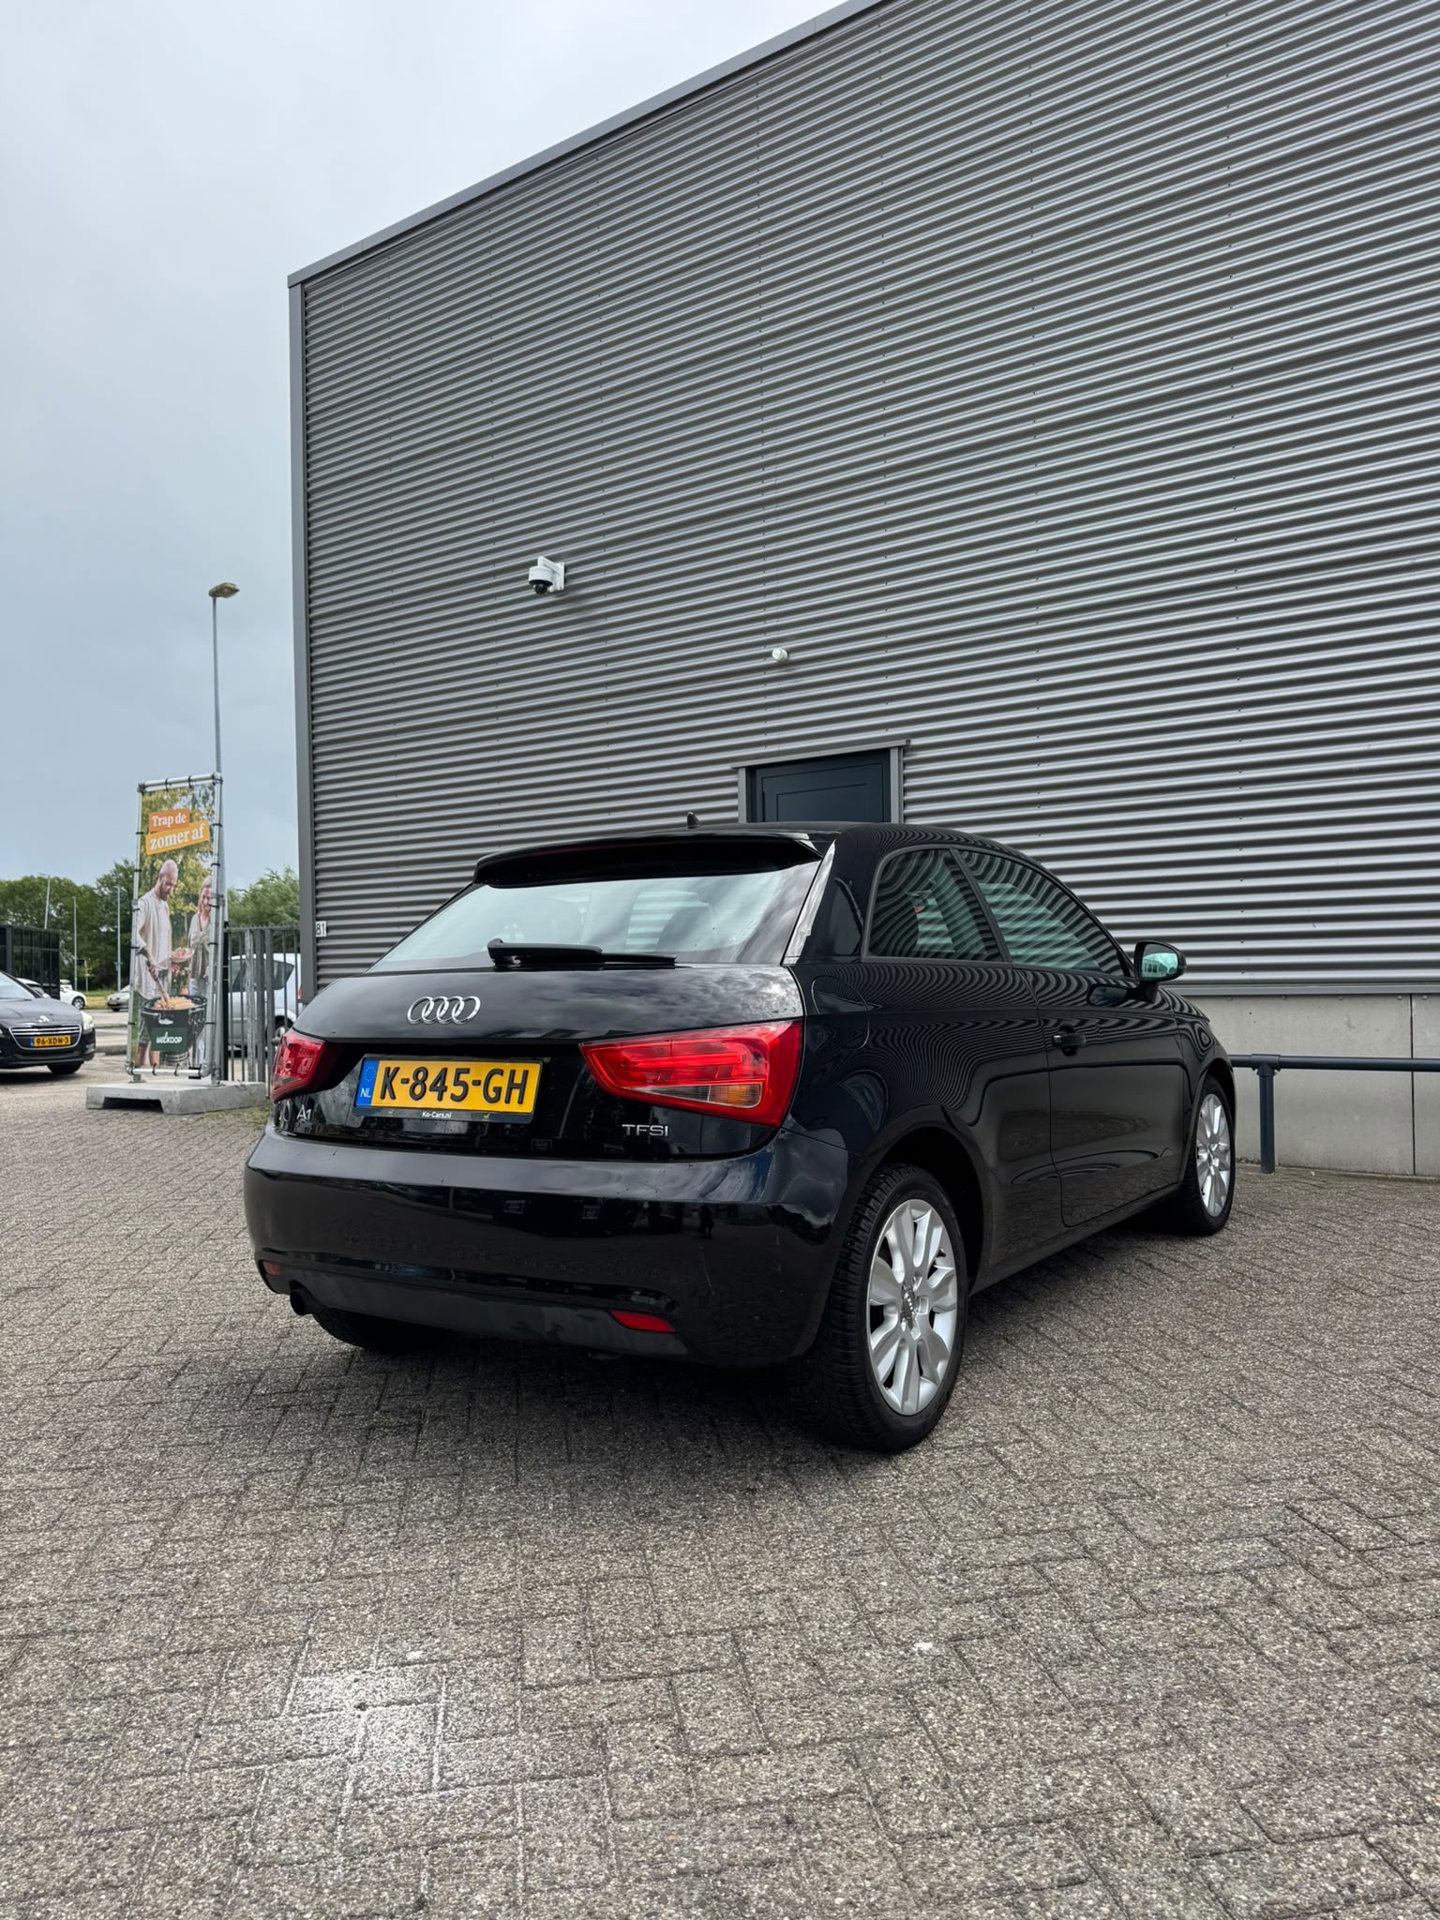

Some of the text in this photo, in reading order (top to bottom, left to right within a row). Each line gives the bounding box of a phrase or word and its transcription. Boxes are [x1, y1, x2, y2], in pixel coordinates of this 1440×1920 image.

[151, 812, 187, 828] Trap de
[149, 822, 206, 851] zomer af
[360, 1066, 529, 1105] NL K-845-GH
[296, 1104, 312, 1120] A1
[621, 1124, 669, 1137] TFSI
